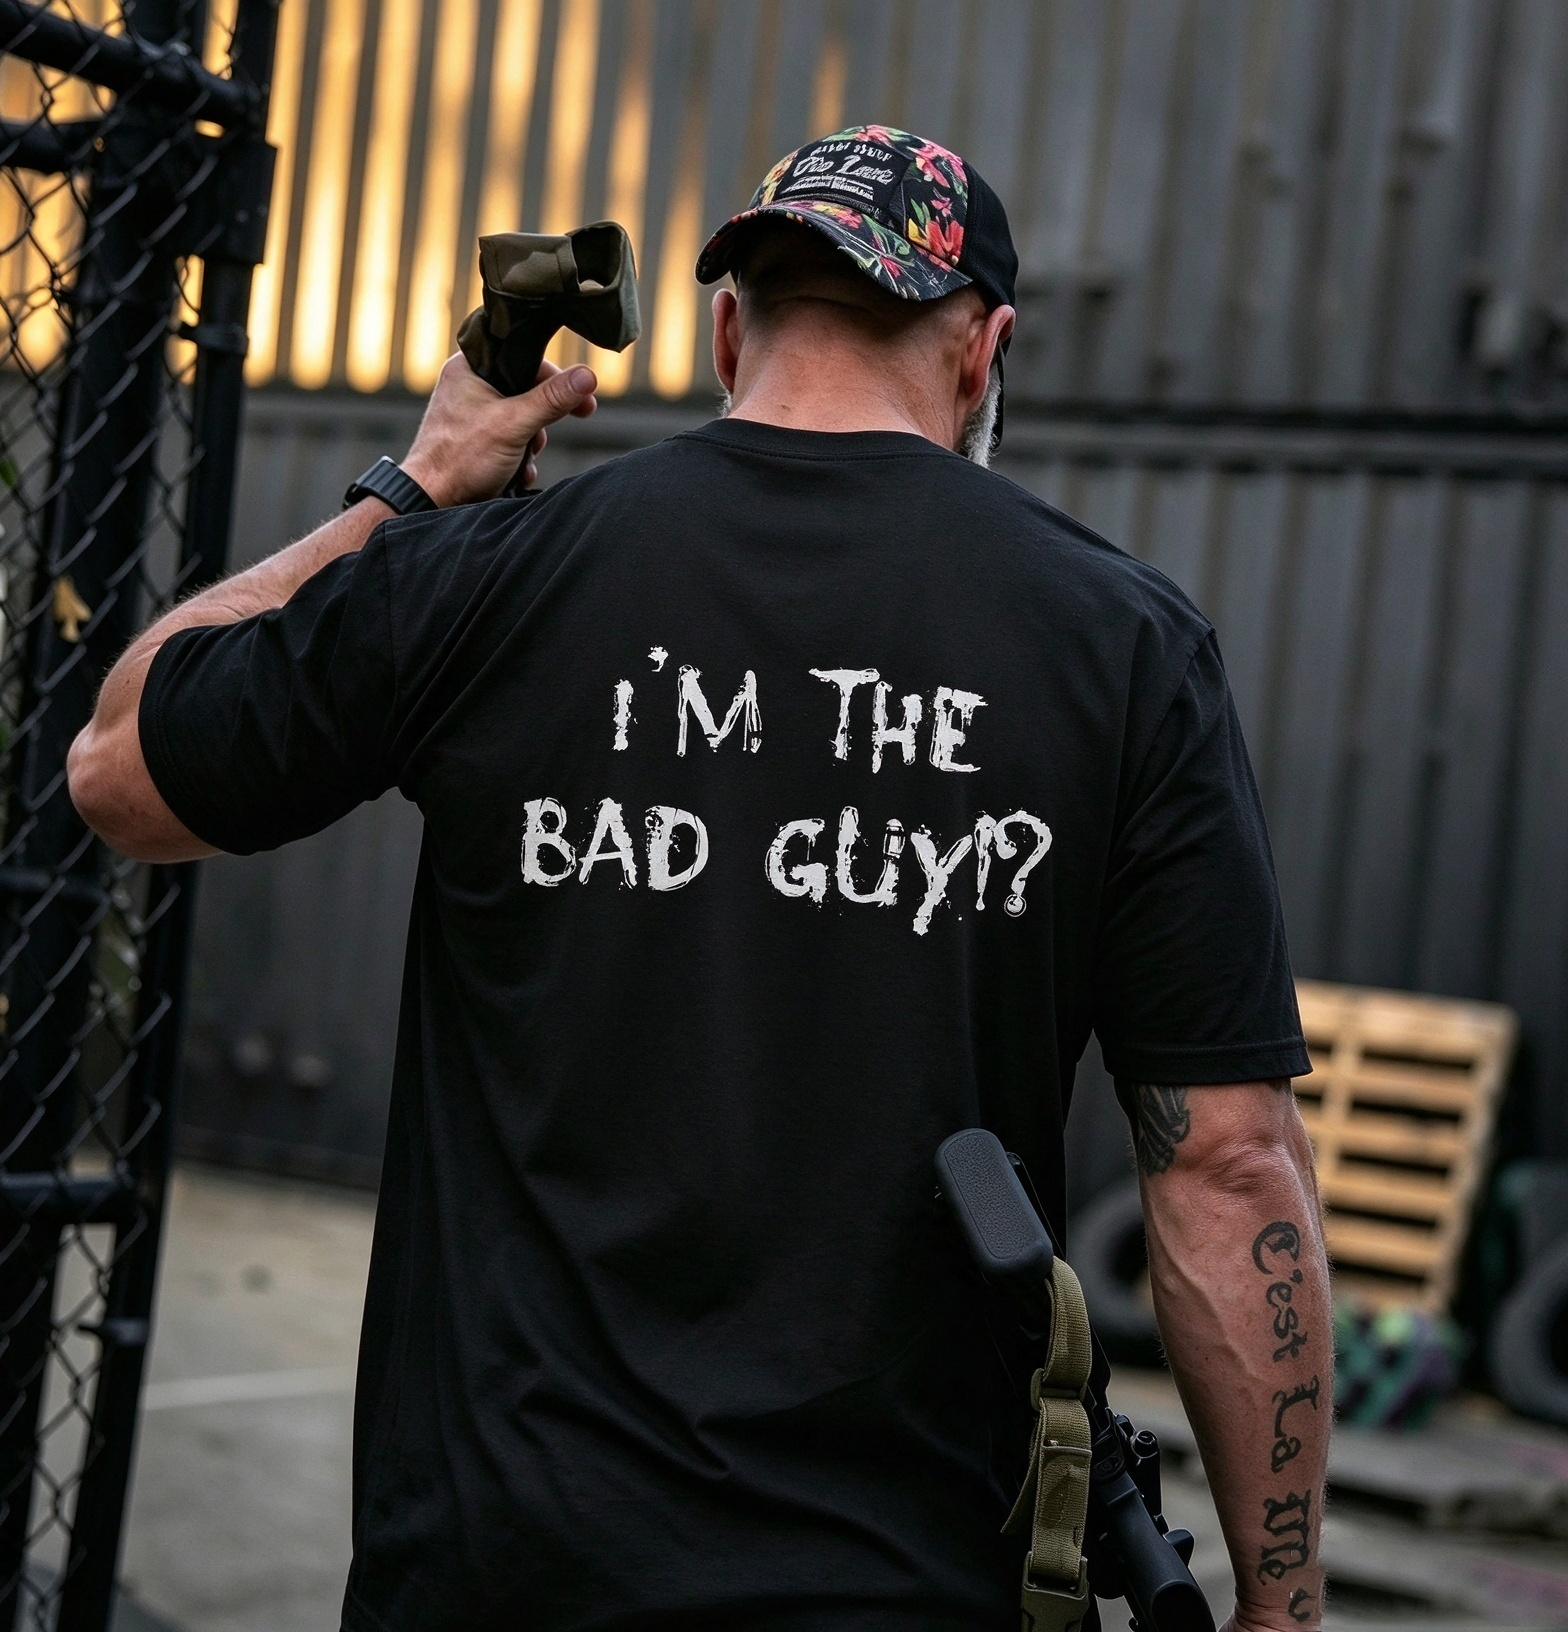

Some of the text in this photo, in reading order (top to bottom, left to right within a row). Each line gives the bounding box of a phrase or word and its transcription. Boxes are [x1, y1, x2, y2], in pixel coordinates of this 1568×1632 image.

[614, 647, 987, 773] I'M THE
[521, 797, 1052, 935] BAD GUY!?
[1251, 1221, 1309, 1363] C'est
[1270, 1374, 1321, 1473] La
